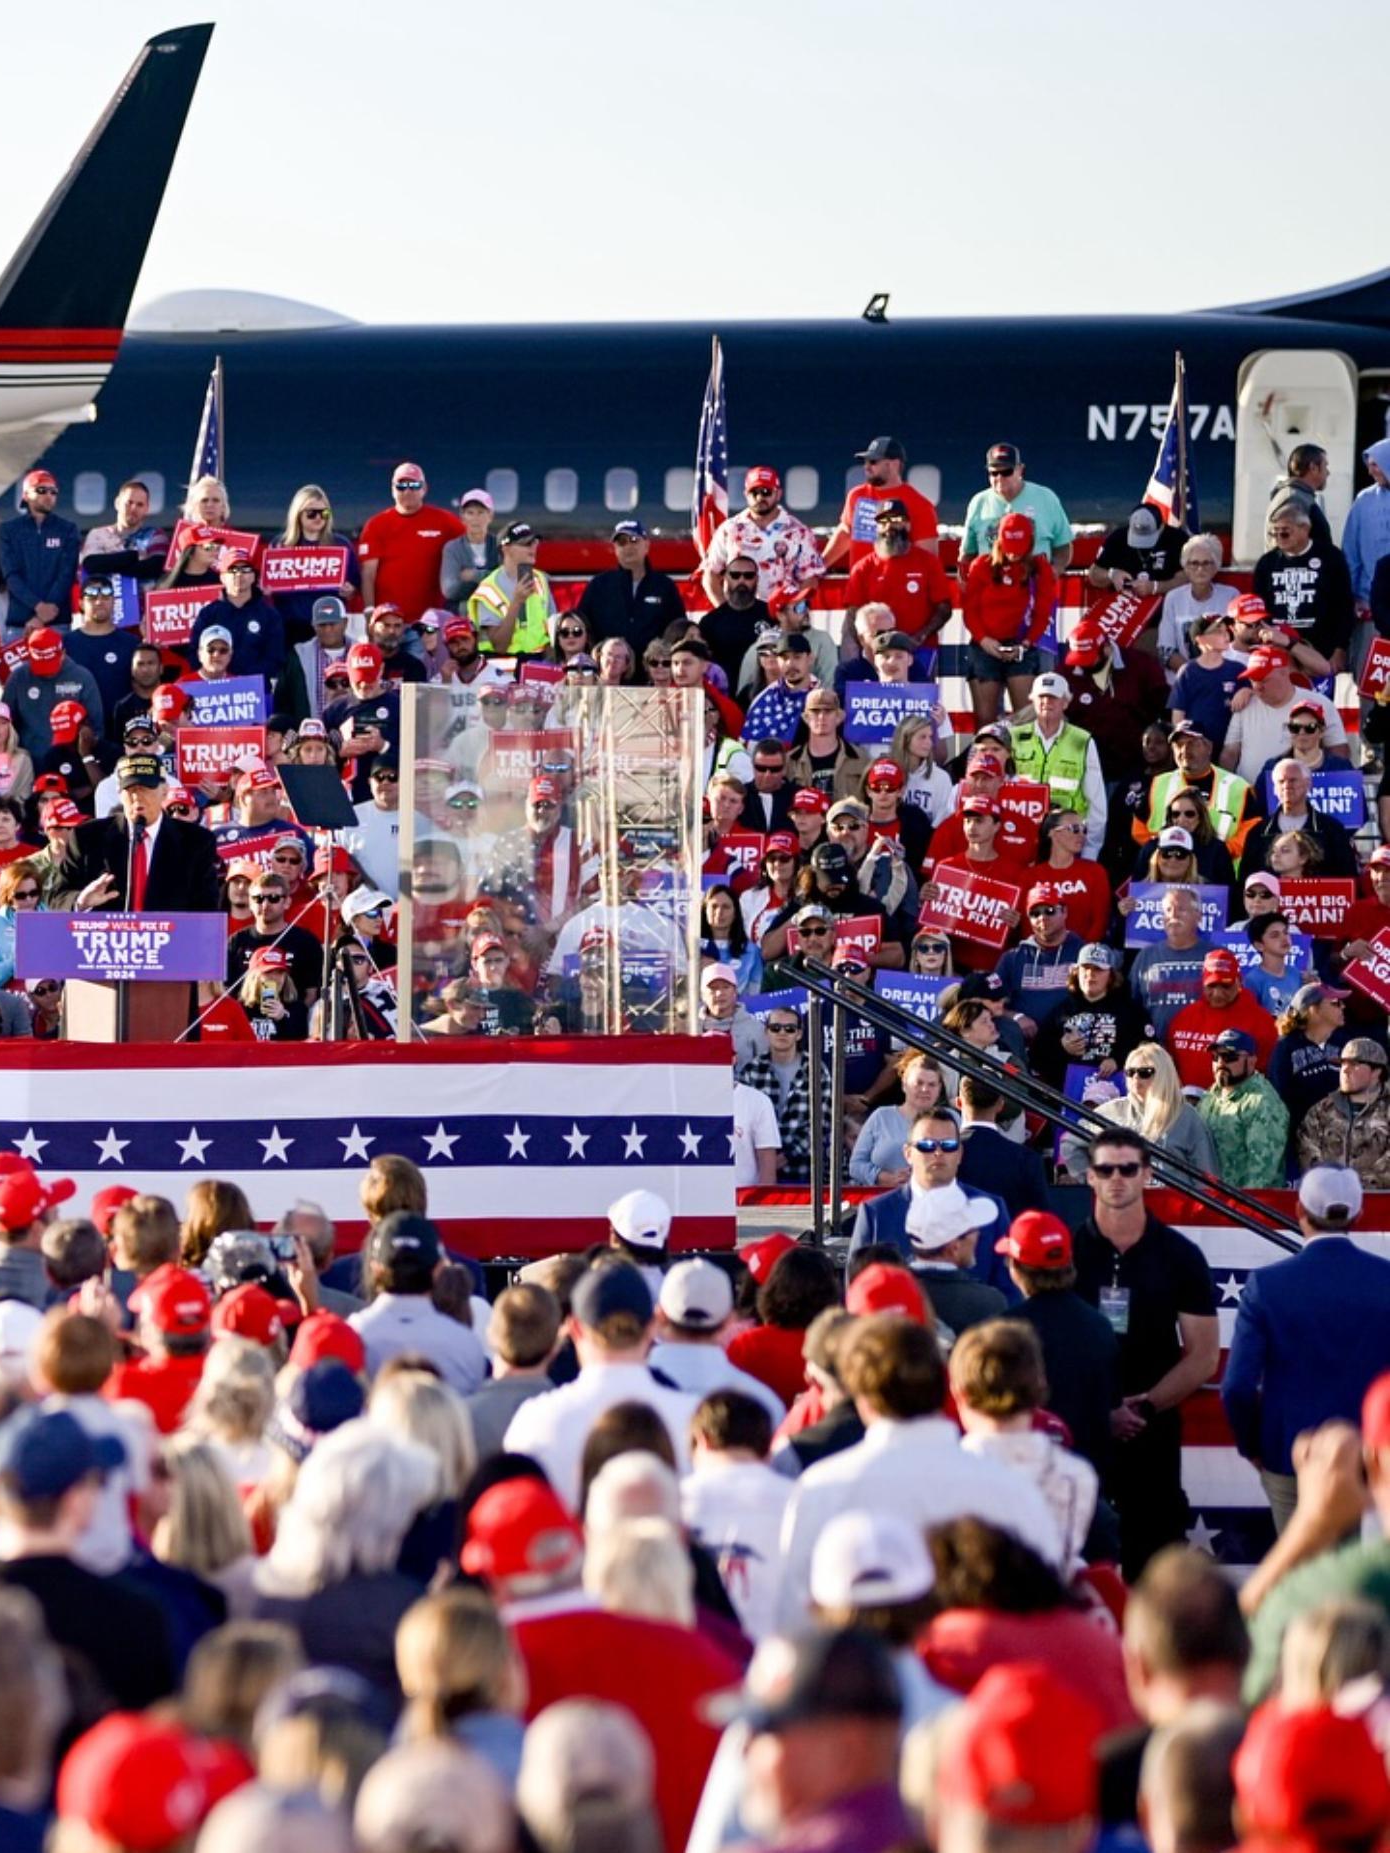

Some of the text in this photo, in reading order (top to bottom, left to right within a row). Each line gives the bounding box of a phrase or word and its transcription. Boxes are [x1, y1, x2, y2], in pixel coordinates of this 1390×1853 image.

[267, 557, 341, 570] TRUMP
[266, 566, 339, 579] WILL FIX IT
[151, 603, 212, 621] TRUM
[152, 620, 187, 633] WILL
[234, 691, 261, 706] BIG,
[851, 698, 933, 712] DREAM BIG,
[182, 743, 261, 764] TRUMP
[495, 751, 548, 768] TRU
[183, 759, 215, 774] WILL
[1329, 787, 1357, 802] BIG,
[1310, 799, 1351, 815] AIN!
[1053, 879, 1087, 895] AGA
[1321, 896, 1351, 910] BIG,
[929, 898, 1005, 931] WILL FIX IT
[1282, 907, 1345, 925] GAIN!
[73, 921, 170, 931] TRUMP WILL FIX IT
[71, 931, 171, 949] TRUMP
[83, 949, 160, 965] VANCE
[105, 970, 136, 979] 2024
[881, 988, 935, 1005] DREAM
